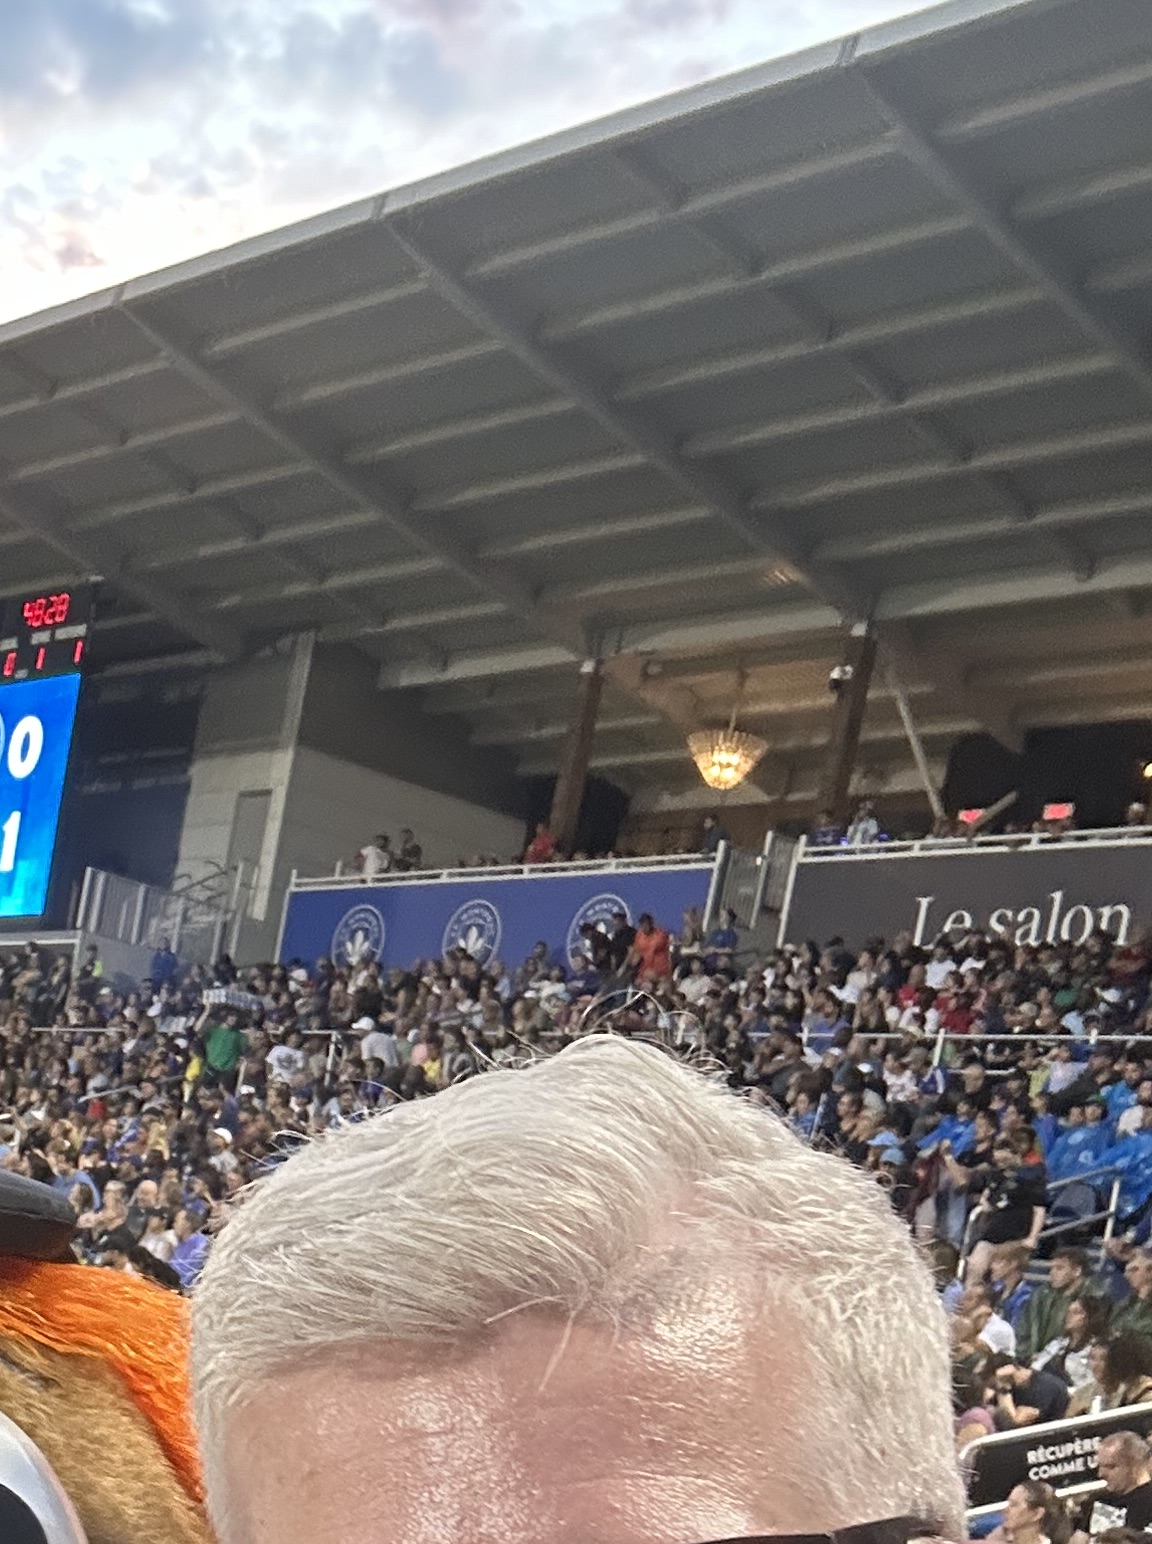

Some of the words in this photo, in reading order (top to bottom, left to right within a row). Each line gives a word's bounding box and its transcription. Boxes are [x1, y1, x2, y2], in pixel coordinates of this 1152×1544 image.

[7, 715, 44, 780] 0
[0, 810, 22, 872] 1
[913, 895, 974, 951] Le
[988, 889, 1132, 948] salon
[1028, 1456, 1086, 1481] COMME
